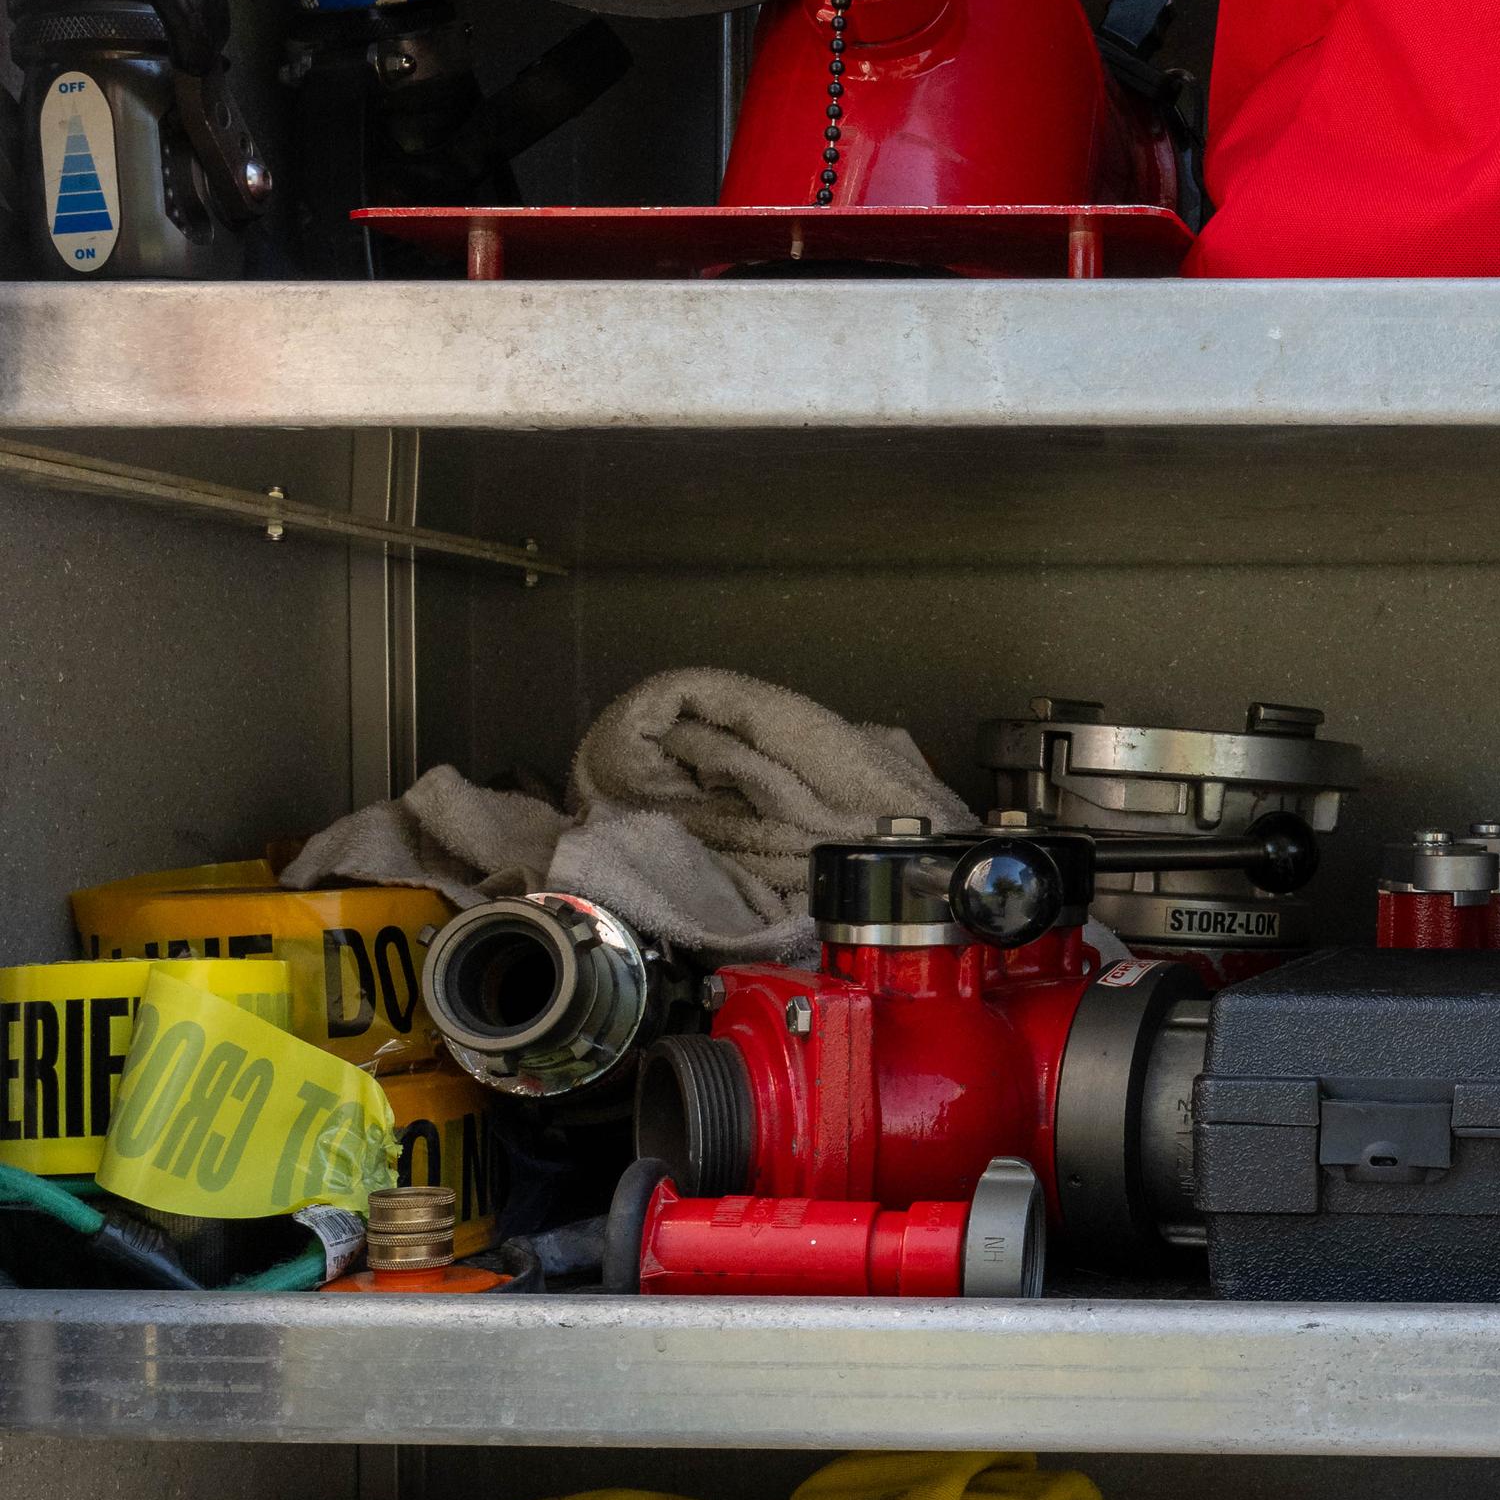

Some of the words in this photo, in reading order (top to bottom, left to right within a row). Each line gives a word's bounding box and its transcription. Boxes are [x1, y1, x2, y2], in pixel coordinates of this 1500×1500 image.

[59, 82, 86, 94] OFF
[75, 248, 96, 260] ON
[1170, 909, 1278, 936] STORZ-LOK
[322, 925, 419, 1039] DO
[0, 997, 141, 1141] ERIF
